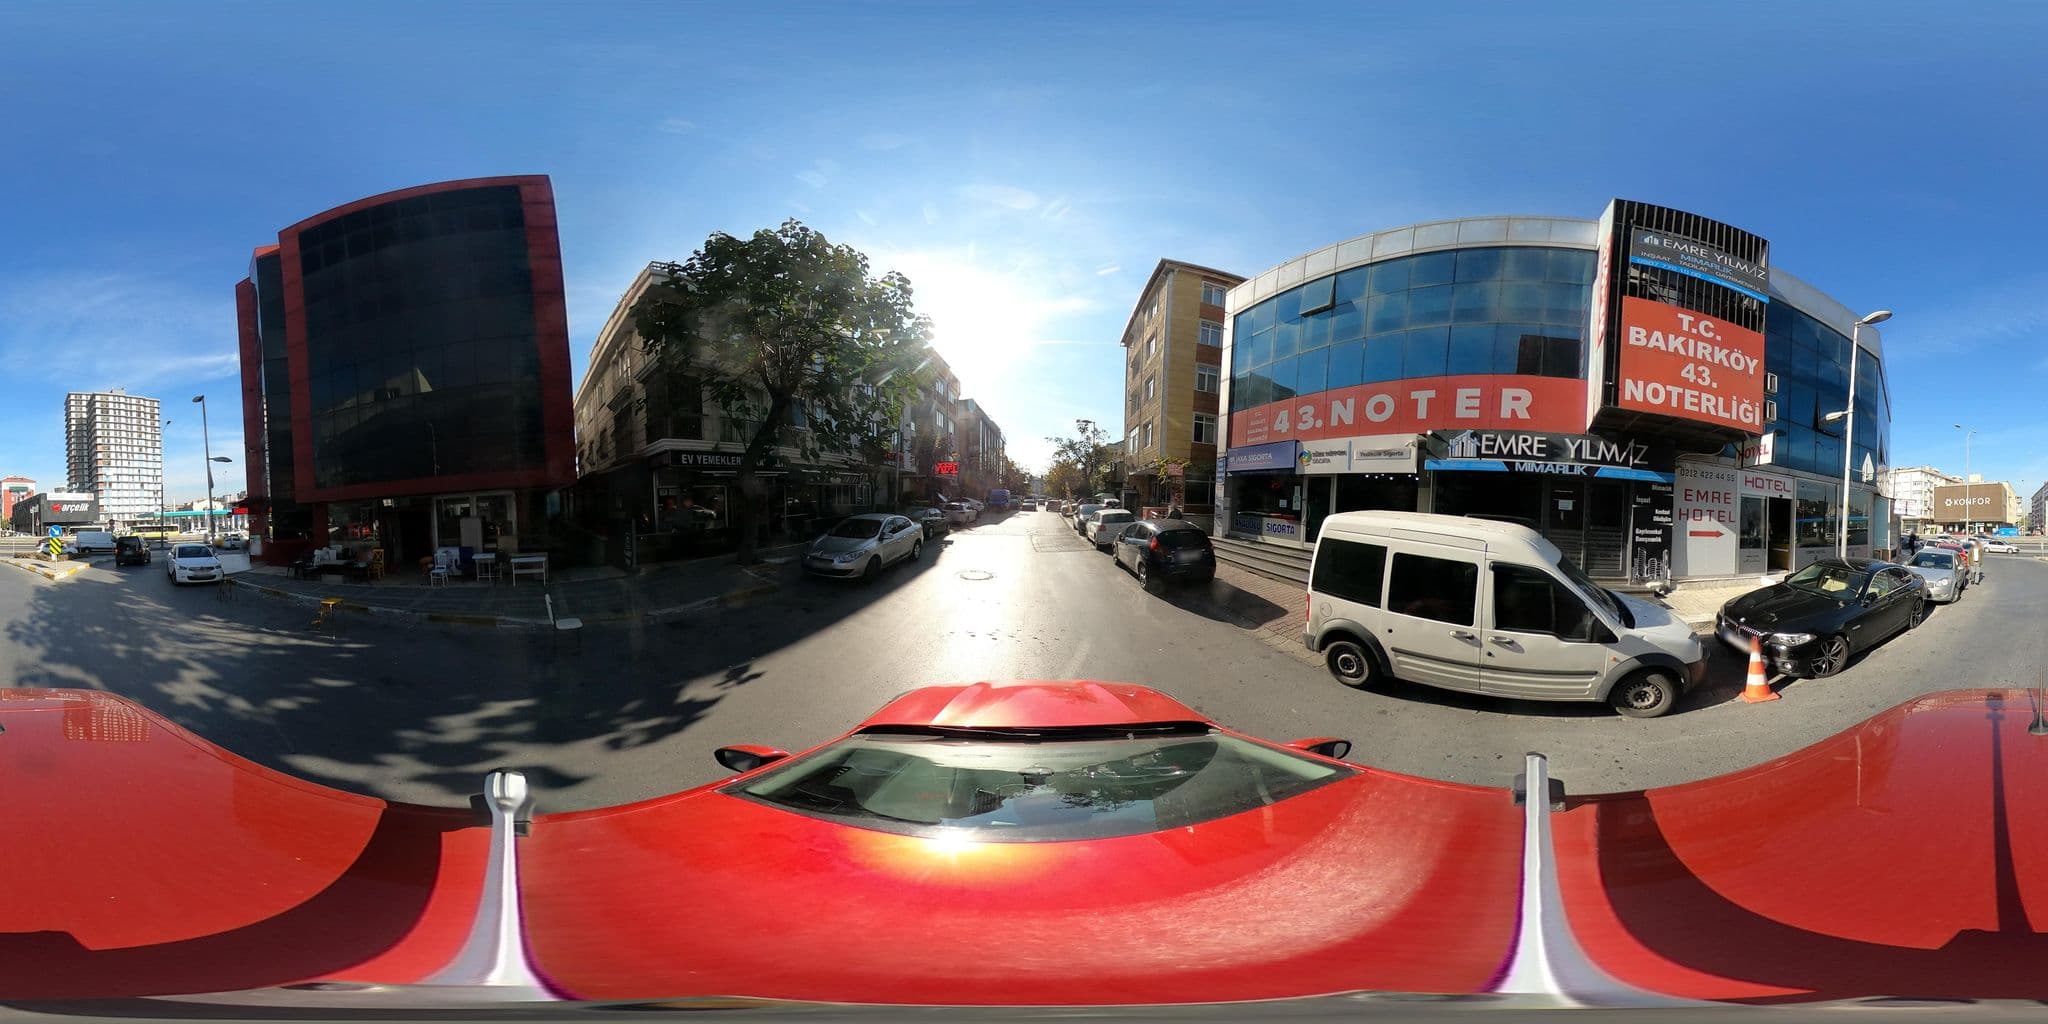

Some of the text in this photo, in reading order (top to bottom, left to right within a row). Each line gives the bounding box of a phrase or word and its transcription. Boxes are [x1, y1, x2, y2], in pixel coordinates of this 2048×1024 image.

[1663, 238, 1766, 281] EMRE YILMAZ
[1677, 313, 1722, 341] T.C.
[1629, 326, 1759, 375] BAKIRKÖY
[1681, 363, 1718, 389] 43.
[1330, 388, 1533, 427] NOTER
[1624, 378, 1760, 426] NOTERLİĞİ
[1481, 434, 1649, 467] EMRE YILMAZ
[1738, 443, 1770, 460] HOTEL
[681, 454, 694, 465] EV
[696, 455, 744, 466] YEMEKLER
[1680, 468, 1698, 478] 0212
[1744, 475, 1791, 493] HOTEL
[1684, 489, 1732, 504] EMRE
[1953, 497, 1991, 506] KONFOR
[62, 503, 89, 513] arçelik
[1678, 508, 1736, 523] HOTEL
[1266, 522, 1295, 534] SIGORTA
